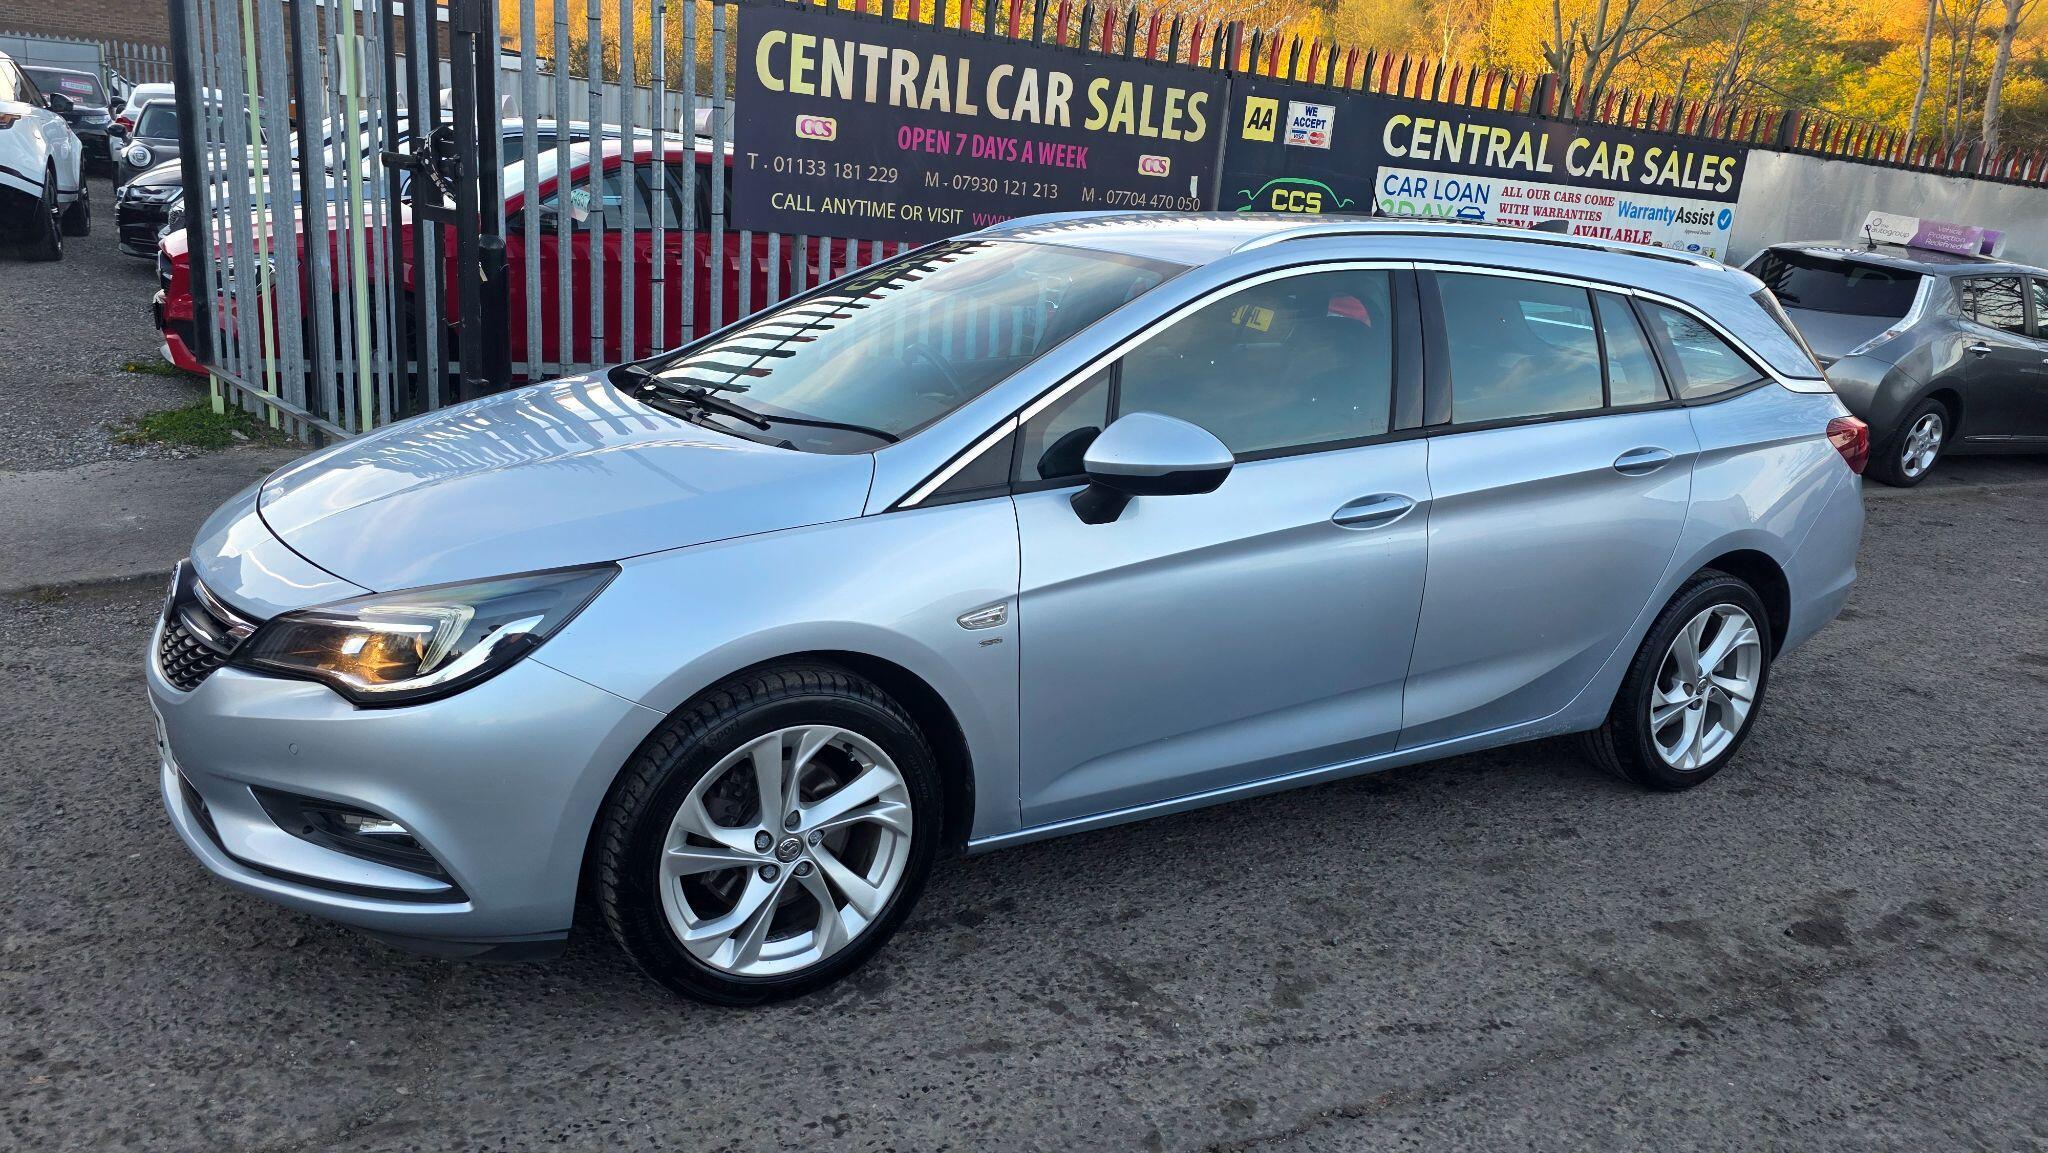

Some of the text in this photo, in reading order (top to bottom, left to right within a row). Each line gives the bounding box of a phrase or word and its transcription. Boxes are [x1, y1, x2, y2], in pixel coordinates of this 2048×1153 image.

[755, 29, 1209, 142] CENTRAL CAR SALES
[1247, 106, 1273, 131] AA
[1293, 117, 1326, 130] ACCEPT
[1305, 106, 1319, 117] WE
[898, 124, 1089, 169] OPEN 7 DAYS A WEEK
[1383, 114, 1737, 193] CENTRAL CAR SALES
[773, 156, 826, 177] 01133
[834, 162, 861, 180] 181
[867, 165, 899, 183] 229
[952, 174, 998, 193] 07930
[1003, 179, 1026, 196] 121
[1032, 182, 1058, 199] 213
[1384, 174, 1490, 204] CAR LOAN
[1501, 186, 1616, 207] ALL OUR CARS COME
[771, 192, 816, 213] CALL
[821, 197, 896, 219] ANYTIME
[900, 204, 923, 222] OR
[927, 207, 964, 225] VISIT
[1106, 189, 1146, 207] 07704
[1150, 193, 1173, 209] 470
[1178, 197, 1200, 211] 050
[1272, 189, 1322, 213] CCS
[1499, 202, 1603, 222] WITH WARRANTIES
[1572, 224, 1653, 245] AVAILABLE
[1870, 226, 1910, 239] autogroup
[1928, 231, 1966, 243] Protection
